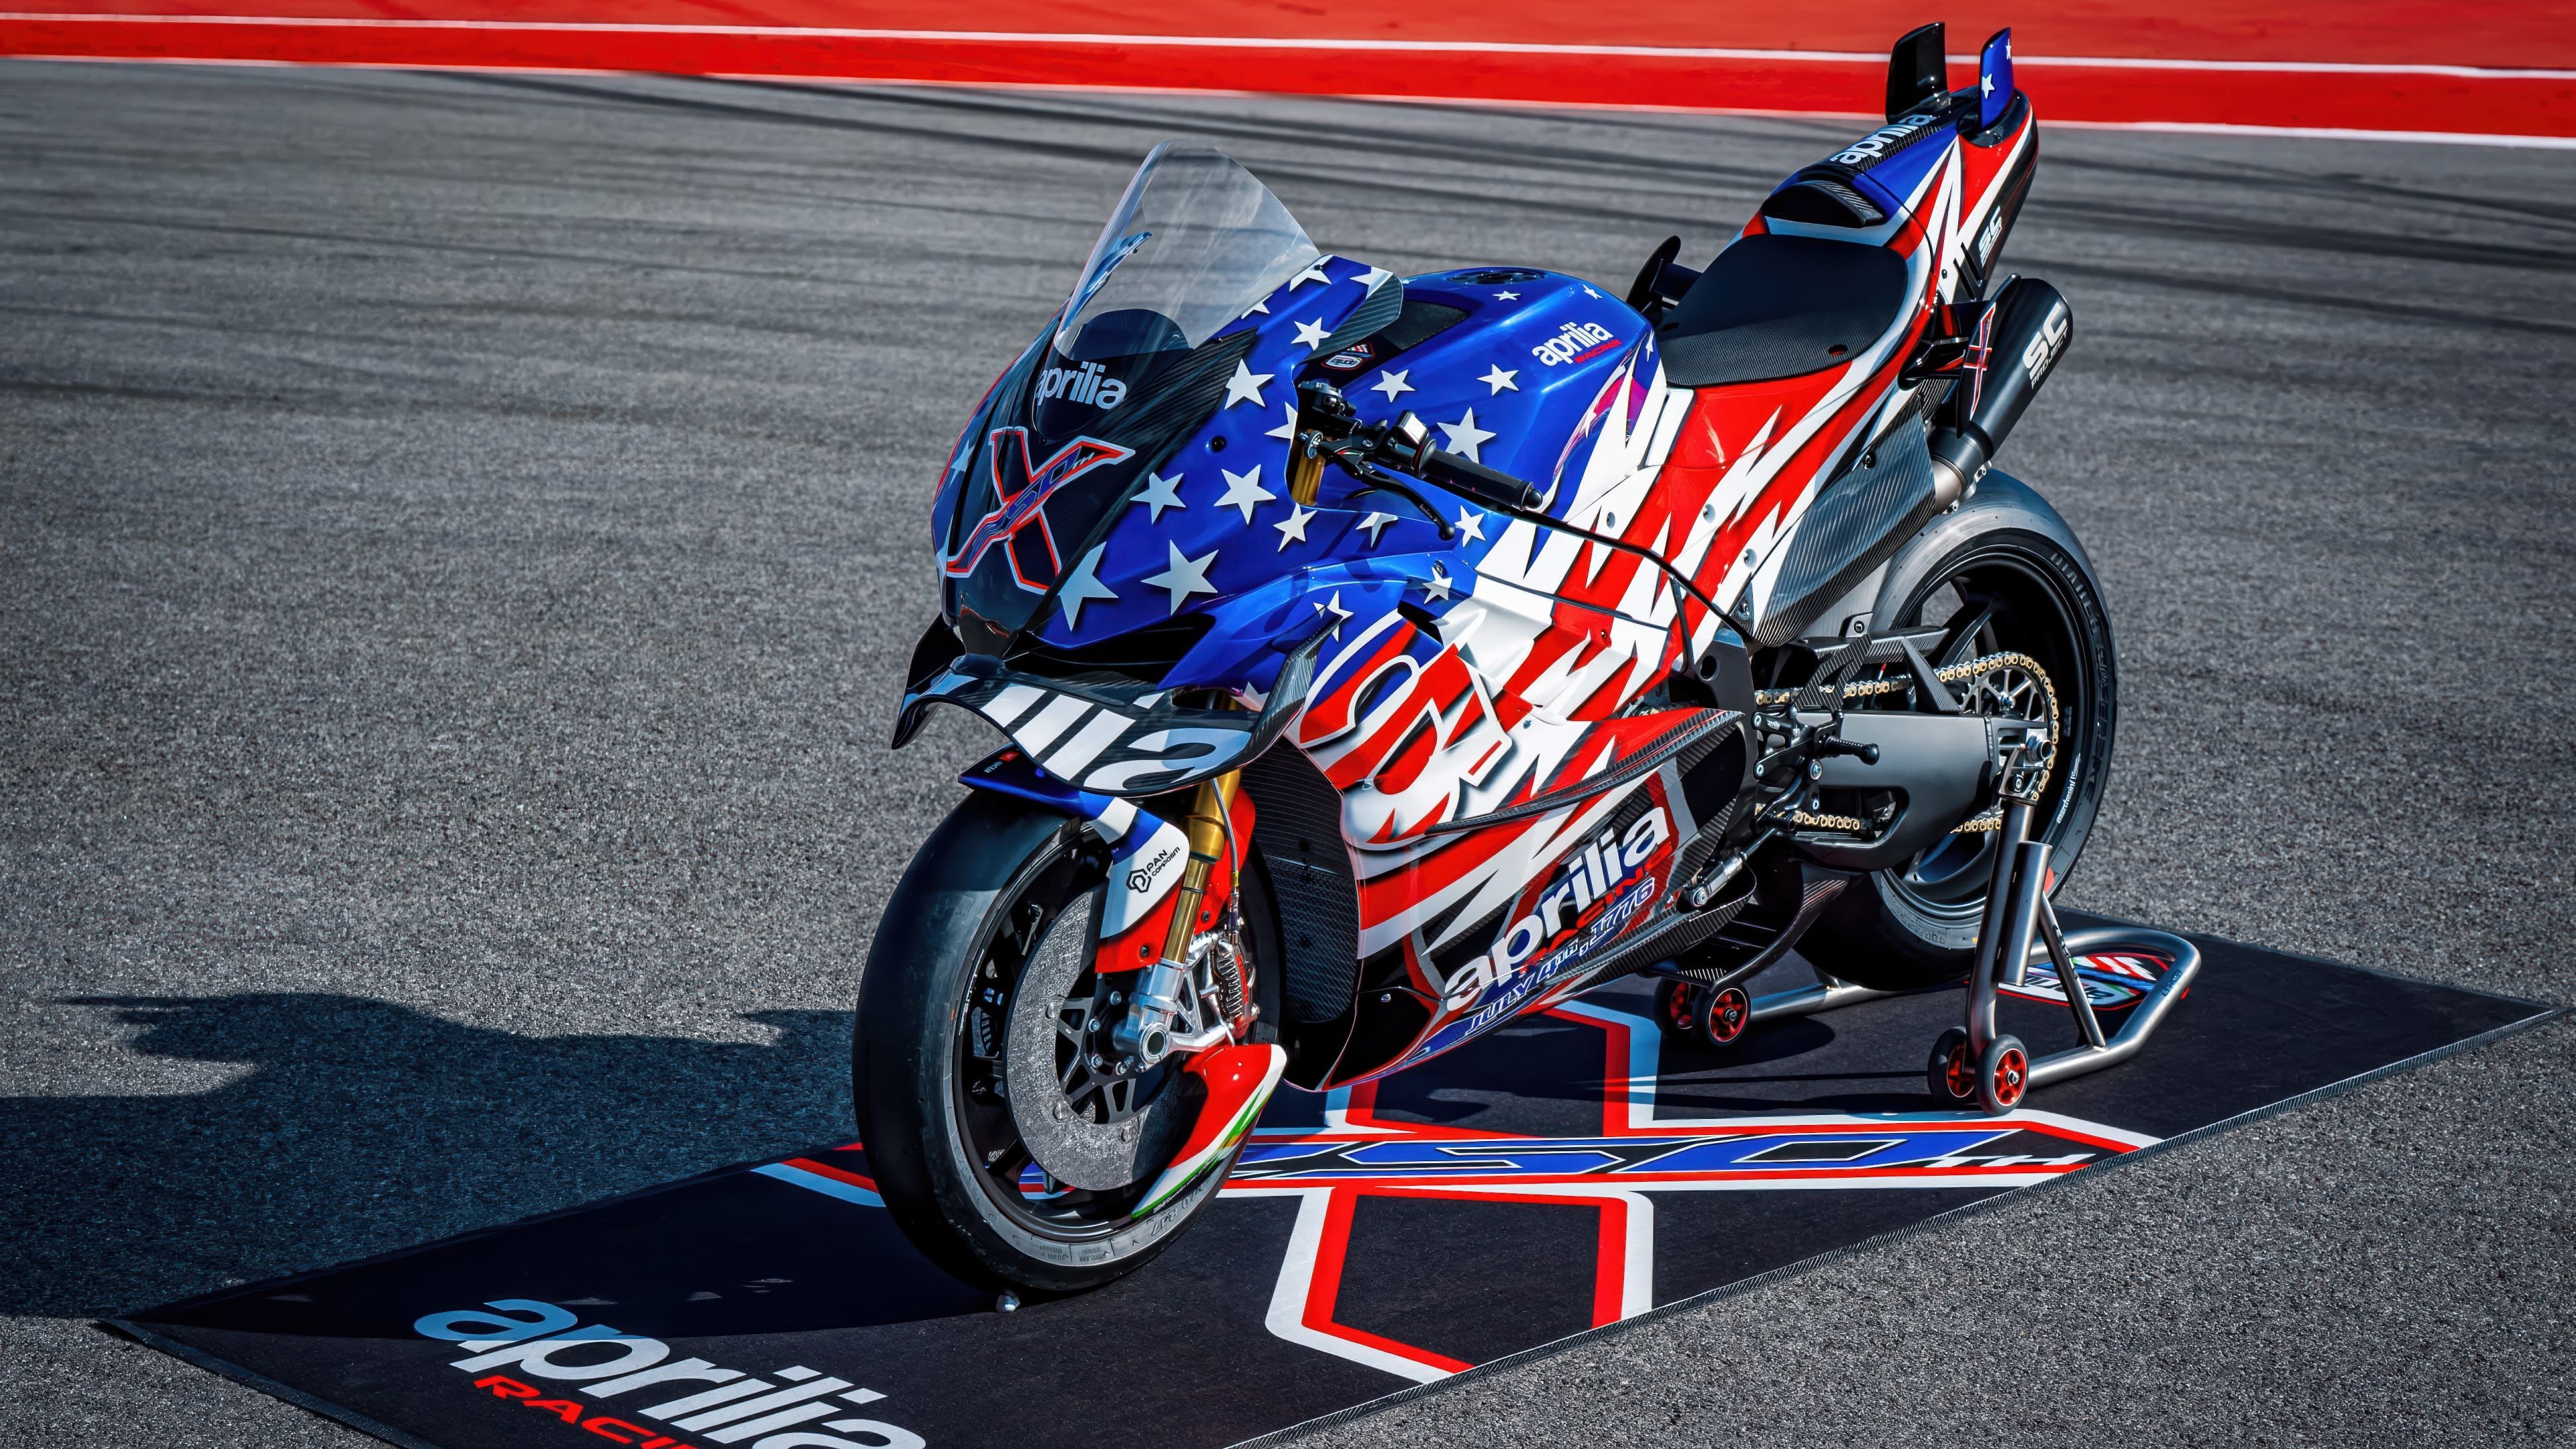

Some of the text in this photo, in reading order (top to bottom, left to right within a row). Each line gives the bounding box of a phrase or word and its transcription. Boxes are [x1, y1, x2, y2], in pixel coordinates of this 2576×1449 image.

[1830, 115, 1937, 164] aprilia
[1532, 322, 1614, 366] aprilia
[2023, 302, 2068, 380] SC
[1035, 361, 1127, 411] aprilia
[1146, 849, 1167, 871] PAN
[1444, 806, 1670, 1012] aprilia
[1519, 842, 1672, 975] RACING
[1464, 971, 1536, 1036] JULY
[1589, 877, 1656, 947] 1776
[413, 1299, 926, 1449] aprilia
[474, 1374, 700, 1449] RACI
